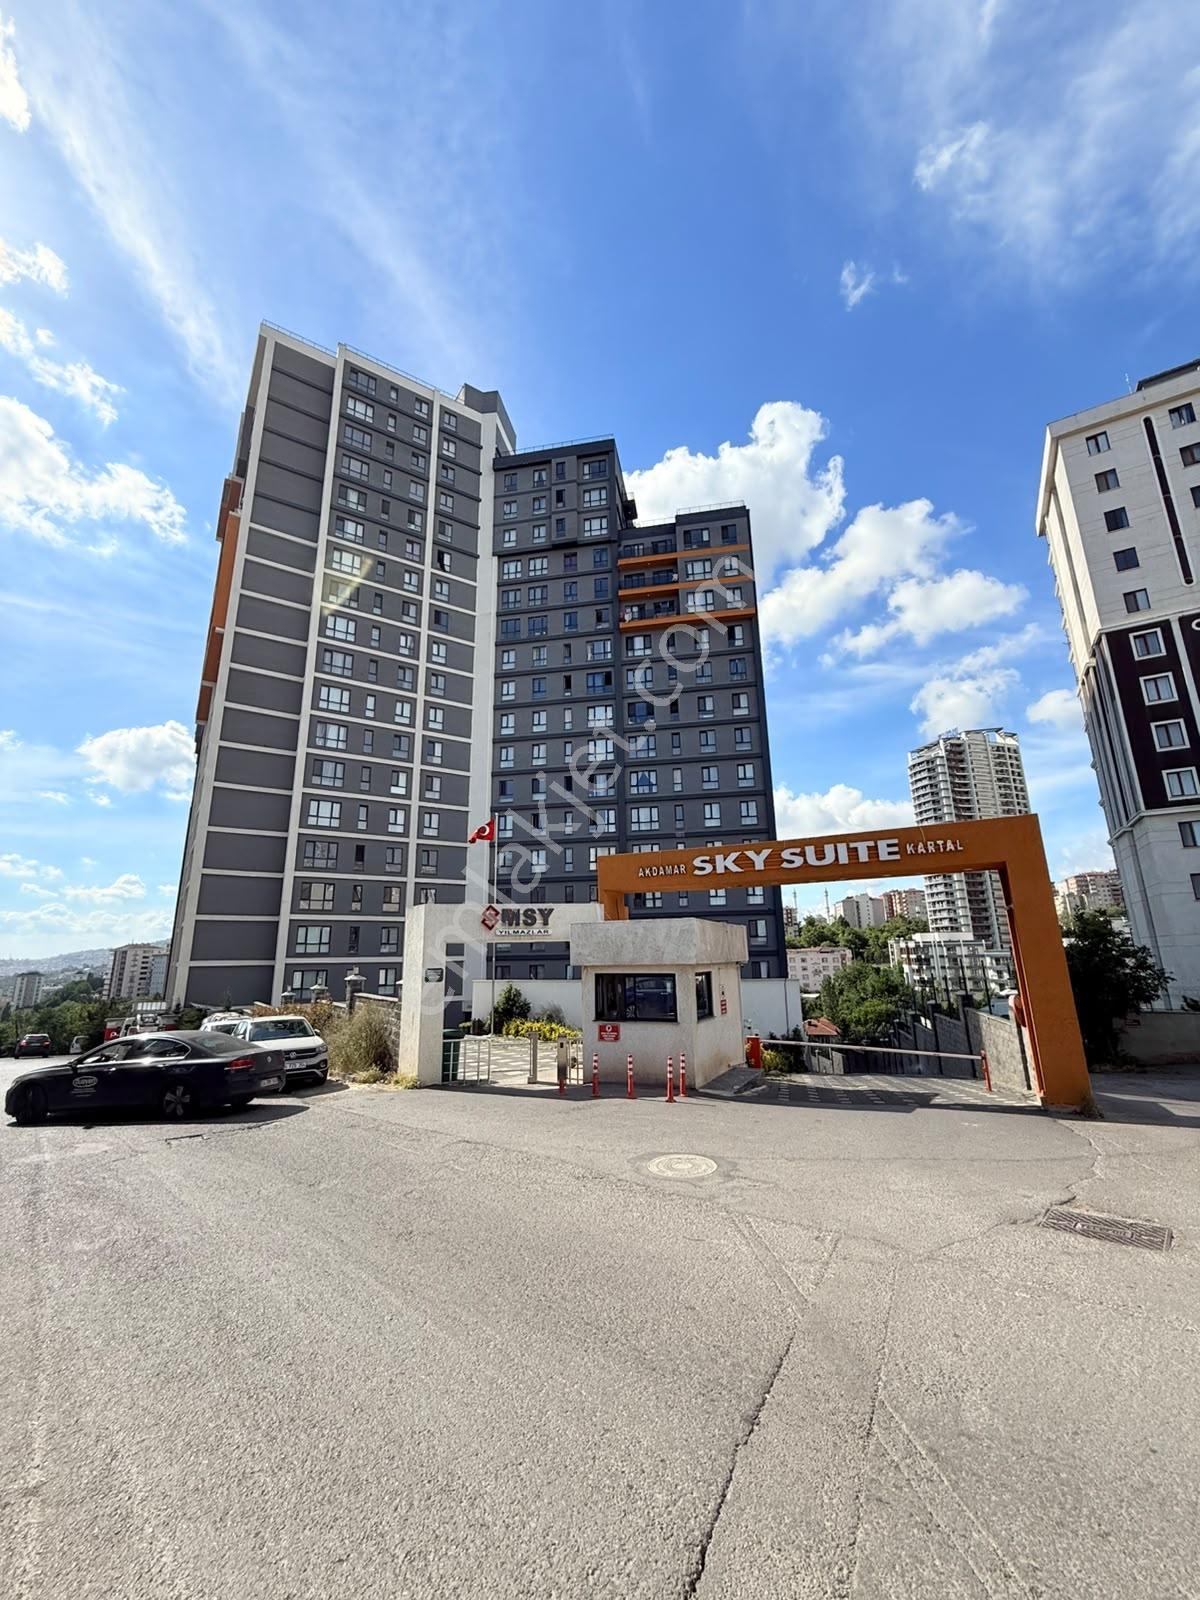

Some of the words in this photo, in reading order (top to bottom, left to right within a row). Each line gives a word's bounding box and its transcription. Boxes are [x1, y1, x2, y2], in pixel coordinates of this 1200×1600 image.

[638, 864, 687, 878] AKDAMAR
[692, 848, 774, 877] SKY
[781, 838, 901, 869] SUITE
[906, 839, 964, 855] KARTAL
[501, 907, 555, 927] MSY
